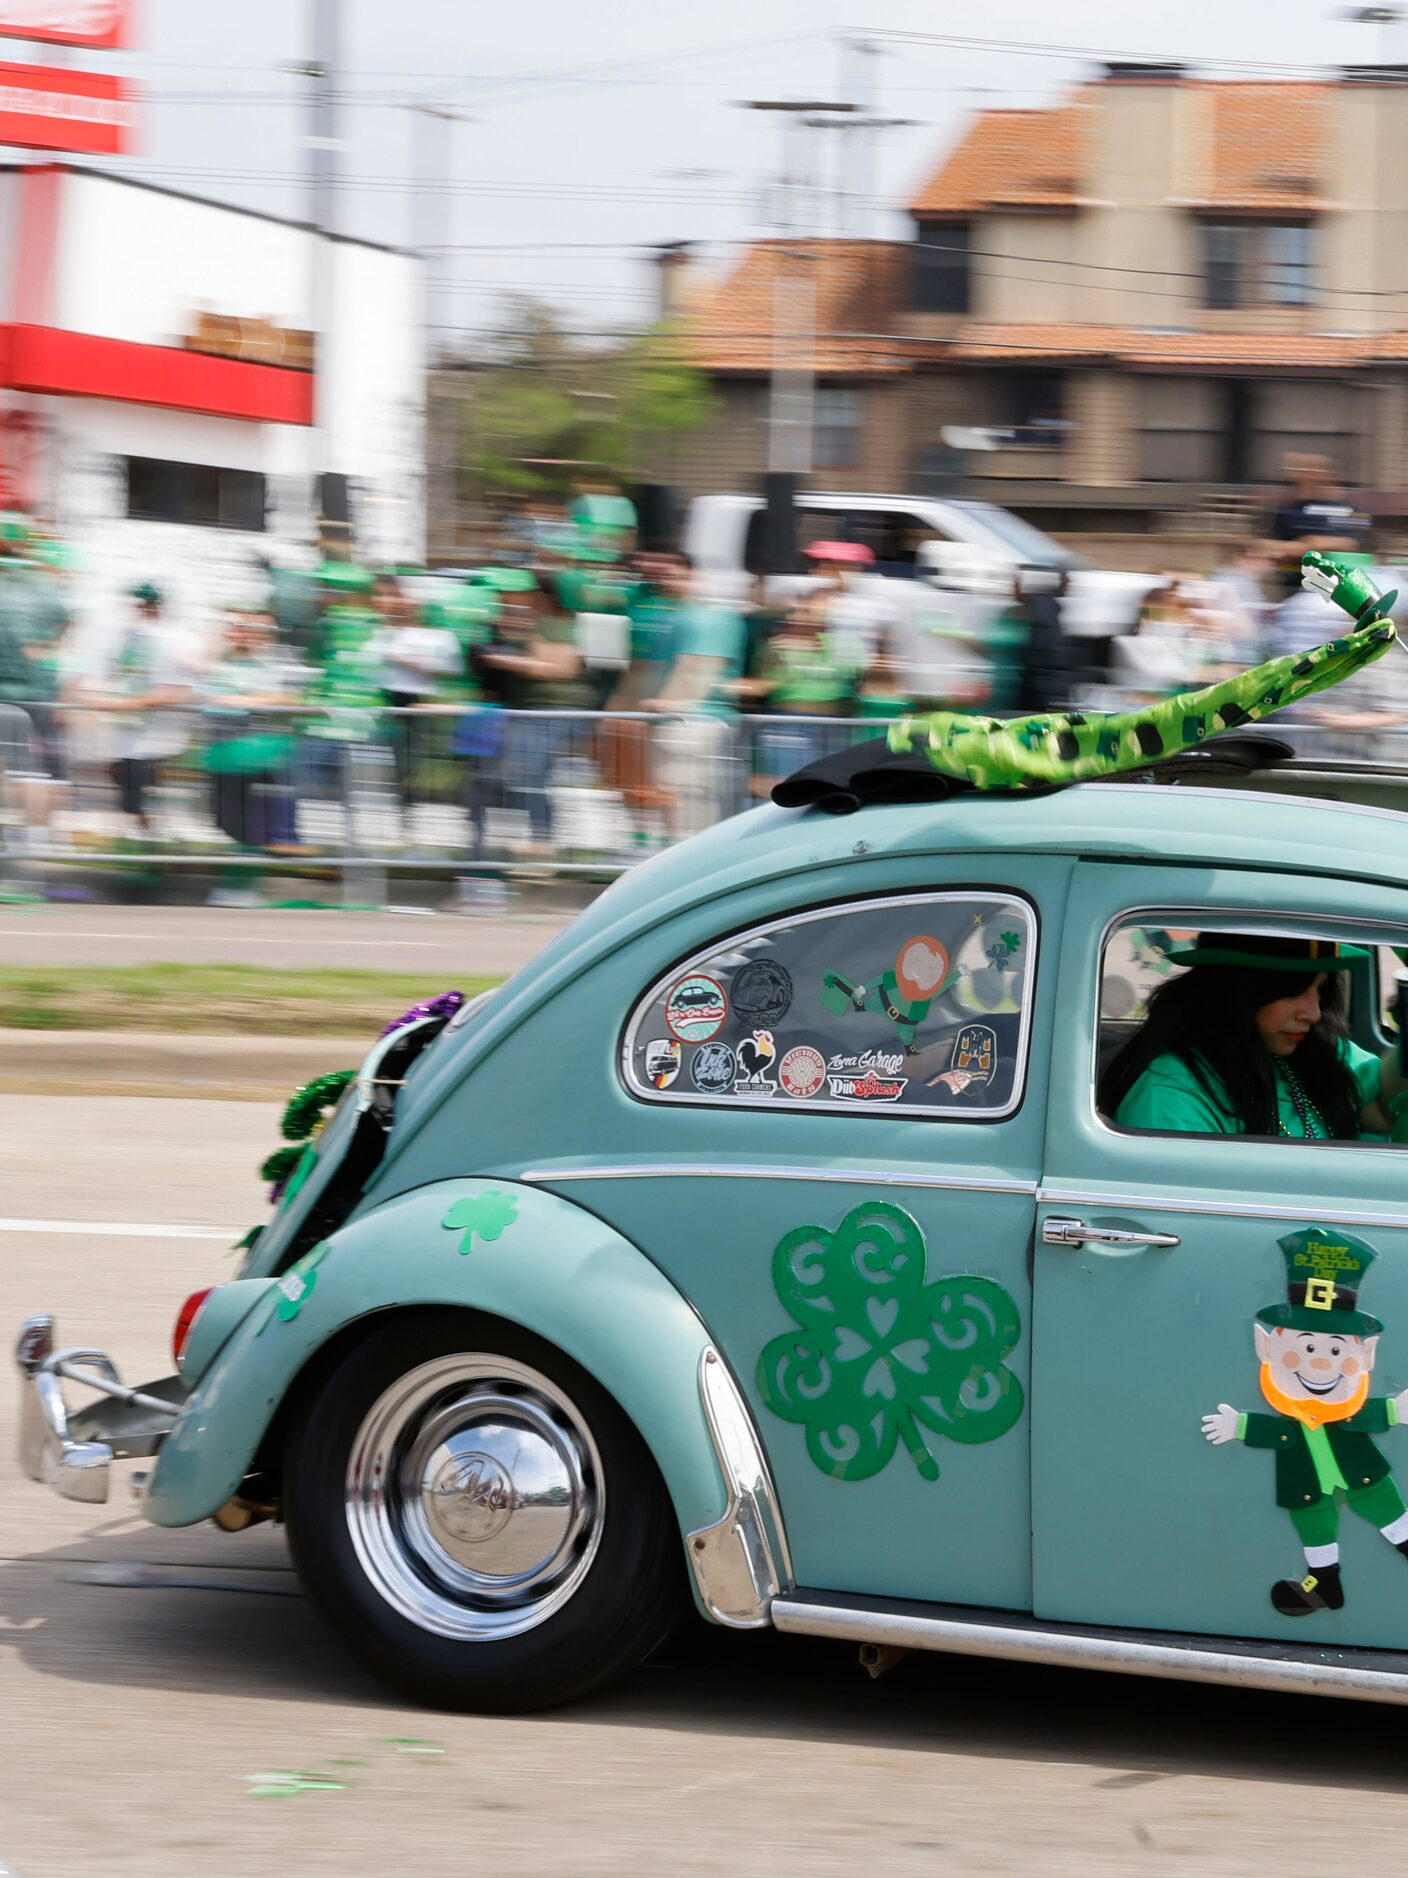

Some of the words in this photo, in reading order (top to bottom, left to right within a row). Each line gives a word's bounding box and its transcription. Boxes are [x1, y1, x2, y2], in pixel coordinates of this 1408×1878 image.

[827, 1053, 857, 1070] Zona
[858, 1049, 904, 1075] Garage
[1307, 1242, 1349, 1258] Happy
[1313, 1268, 1338, 1280] Day
